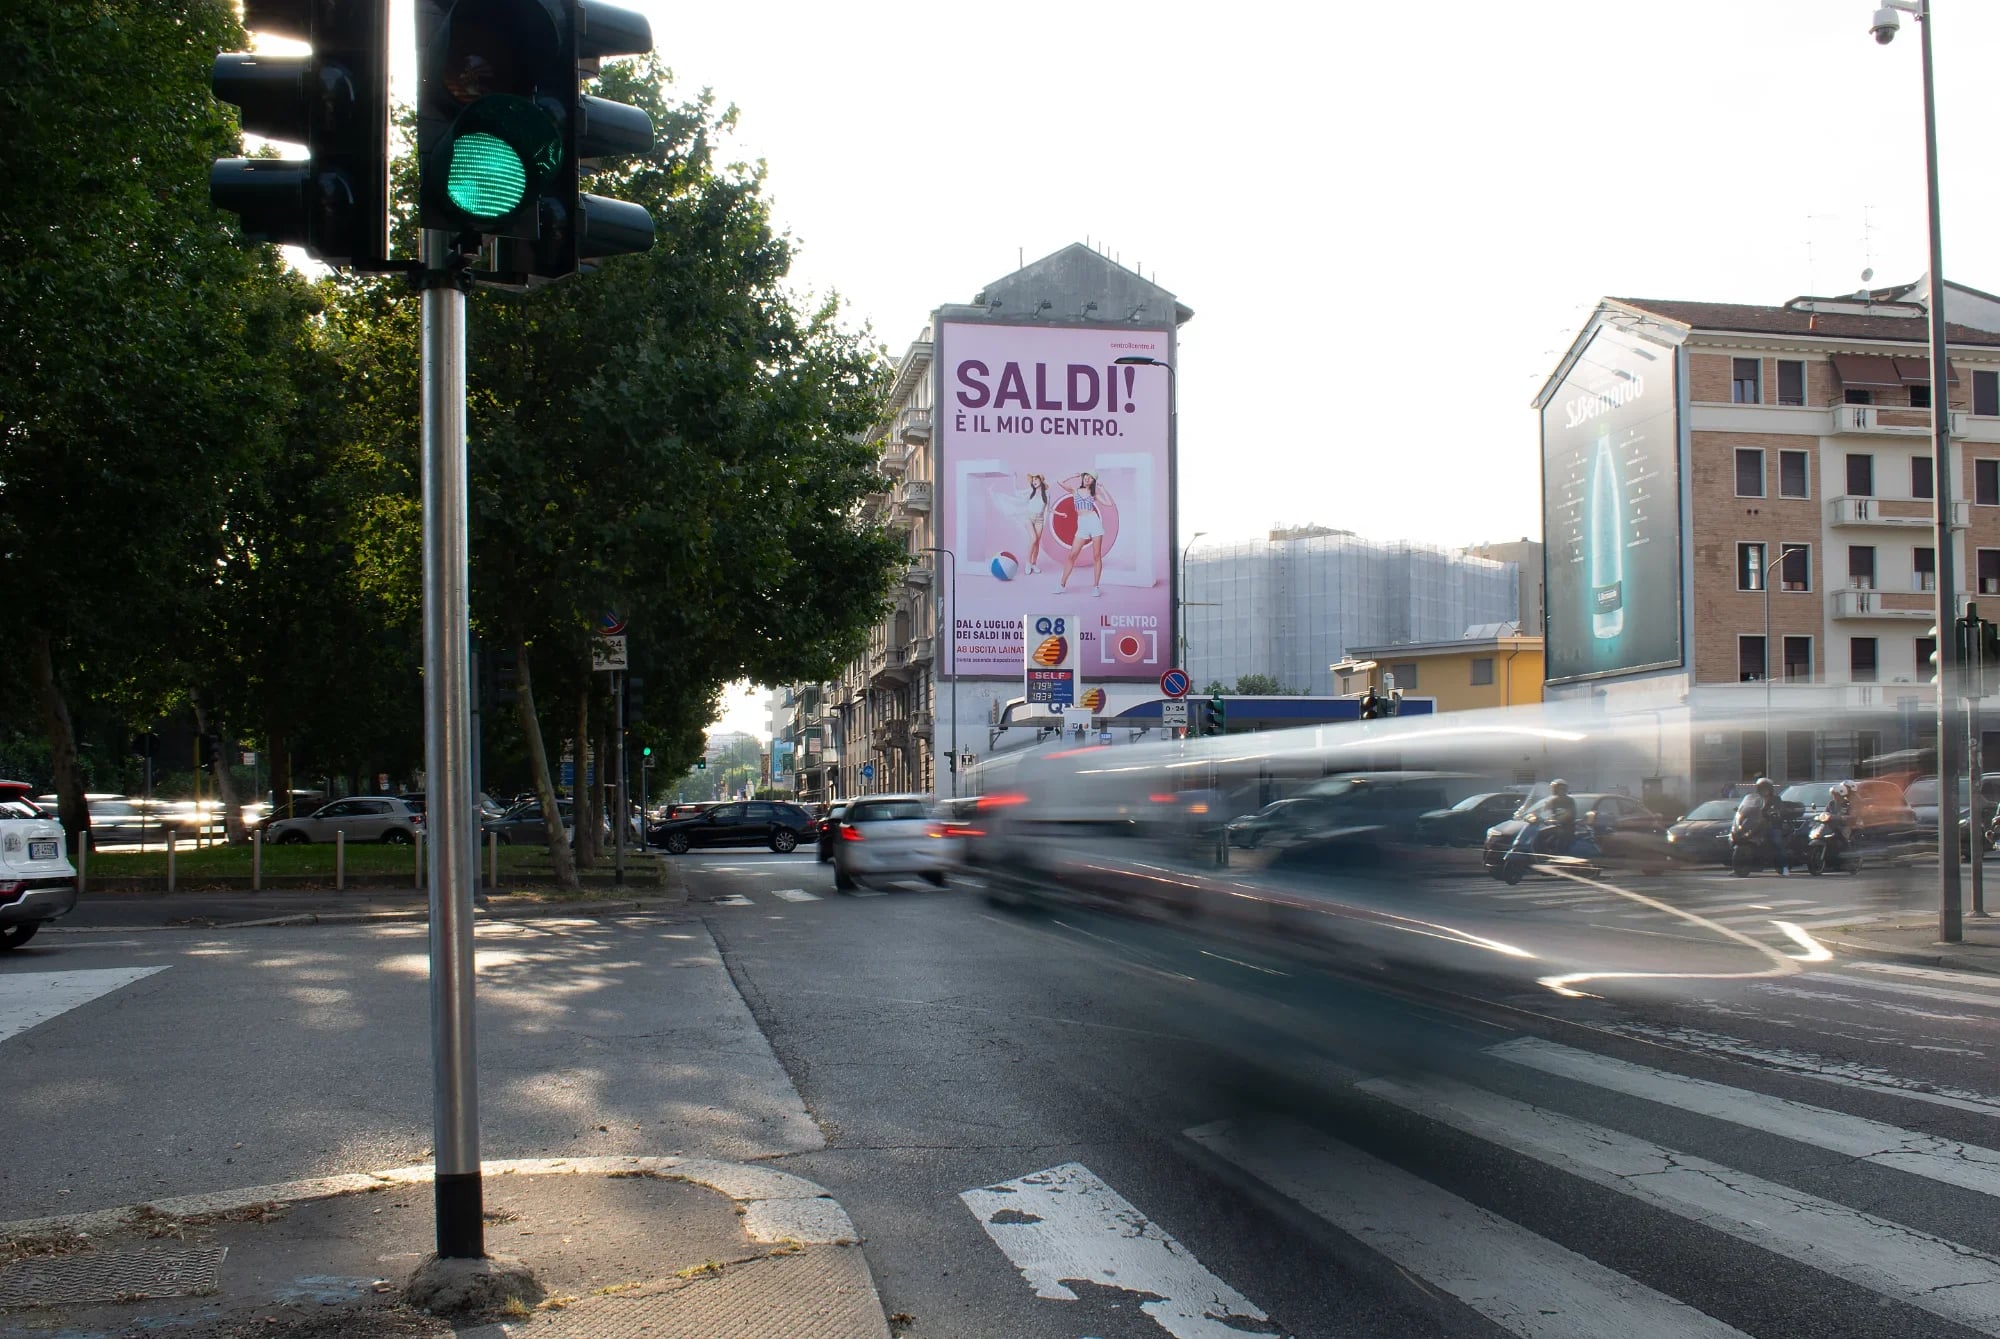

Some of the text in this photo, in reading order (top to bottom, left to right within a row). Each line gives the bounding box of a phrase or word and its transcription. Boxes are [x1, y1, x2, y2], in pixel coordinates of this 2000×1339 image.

[956, 359, 1136, 414] SALDI!
[955, 409, 1124, 437] È IL MIO CENTRO.
[956, 620, 974, 629] DAL
[976, 620, 982, 629] 6
[984, 620, 1015, 629] LUGLIO
[1035, 617, 1066, 635] Q8
[956, 631, 1024, 640] DEI SALDI IN OL
[1080, 632, 1096, 641] OZI.
[610, 639, 622, 647] 24
[957, 645, 1024, 654] A8 USCITA LAINAT
[1035, 671, 1066, 680] SELF
